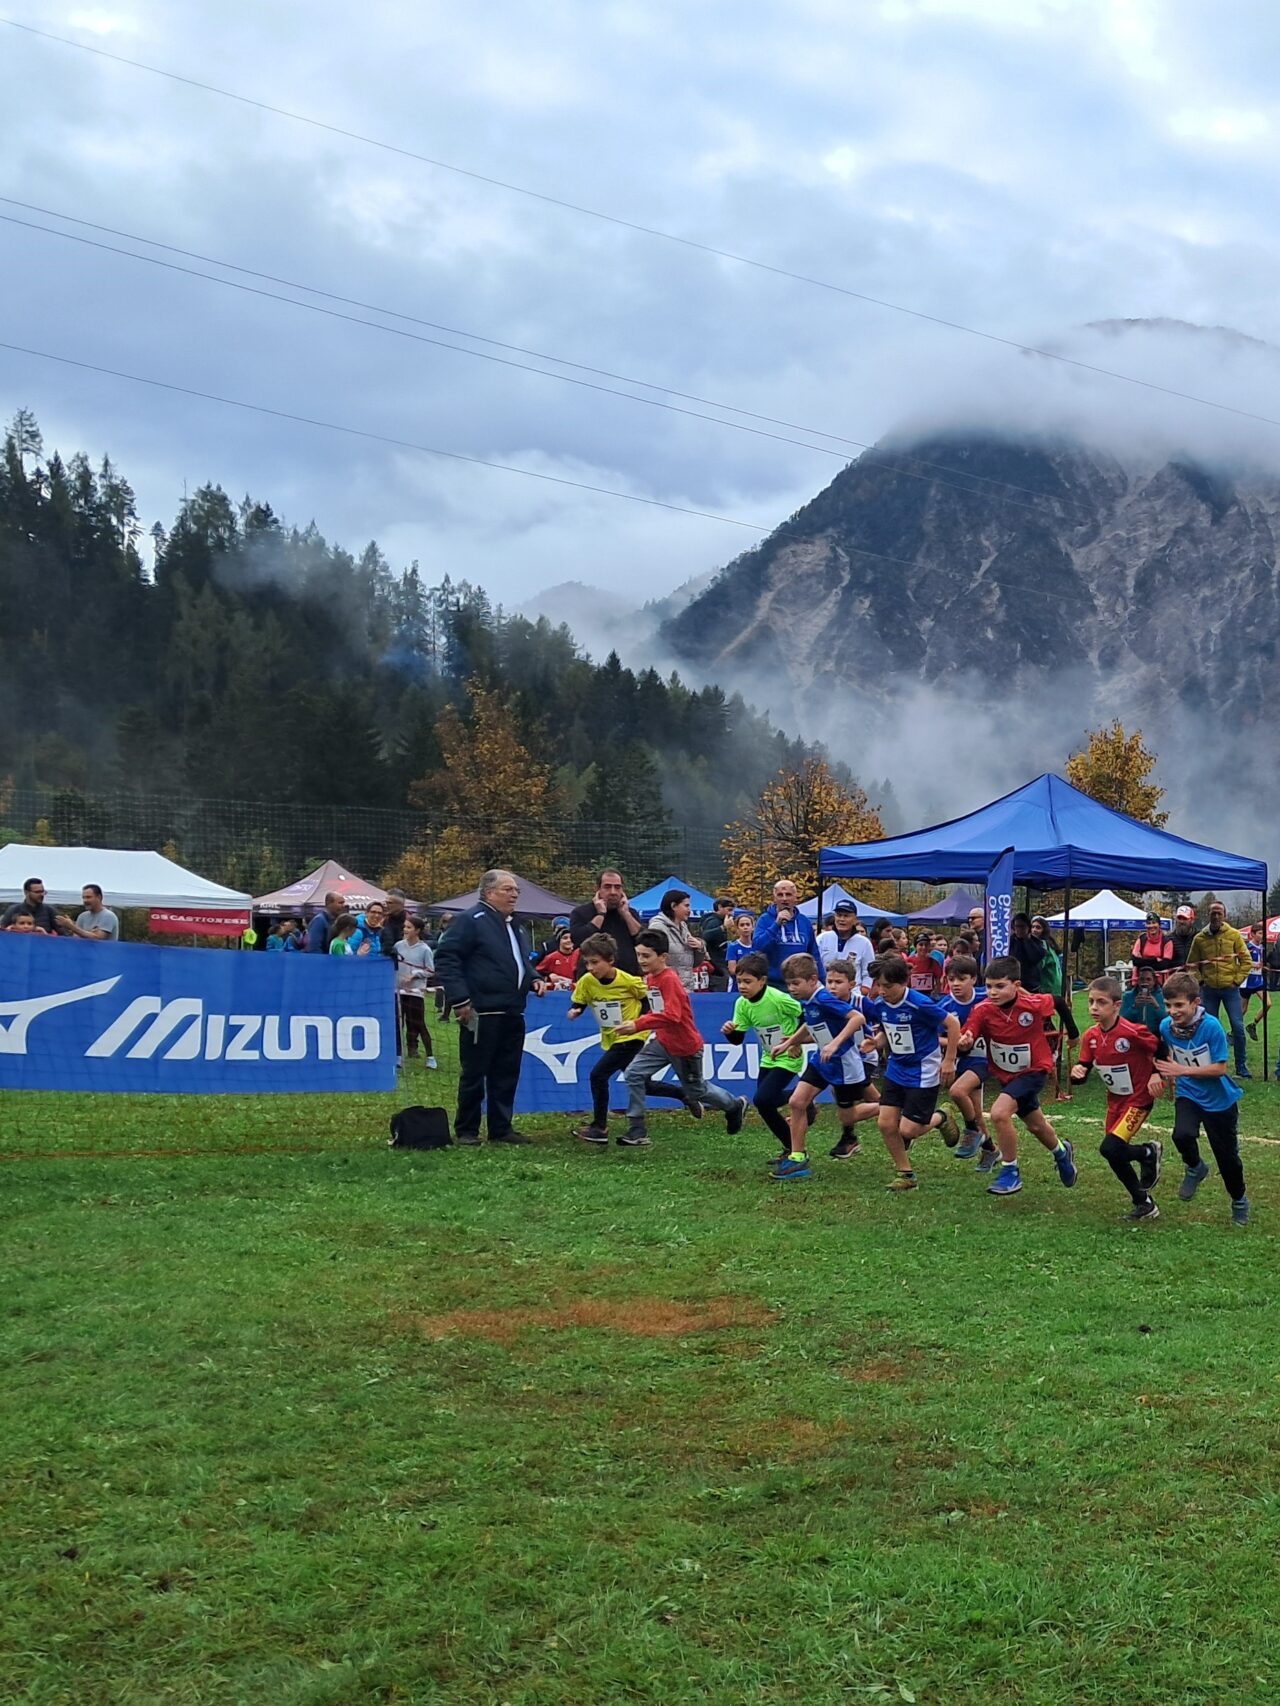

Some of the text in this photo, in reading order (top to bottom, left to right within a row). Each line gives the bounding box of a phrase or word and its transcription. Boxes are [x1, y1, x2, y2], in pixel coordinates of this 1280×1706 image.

[151, 913, 249, 925] GS CASTIONESE
[600, 1008, 609, 1020] 8
[760, 1033, 773, 1046] 17
[889, 1032, 903, 1046] 12
[999, 1052, 1019, 1065] 10
[1103, 1073, 1115, 1086] 3
